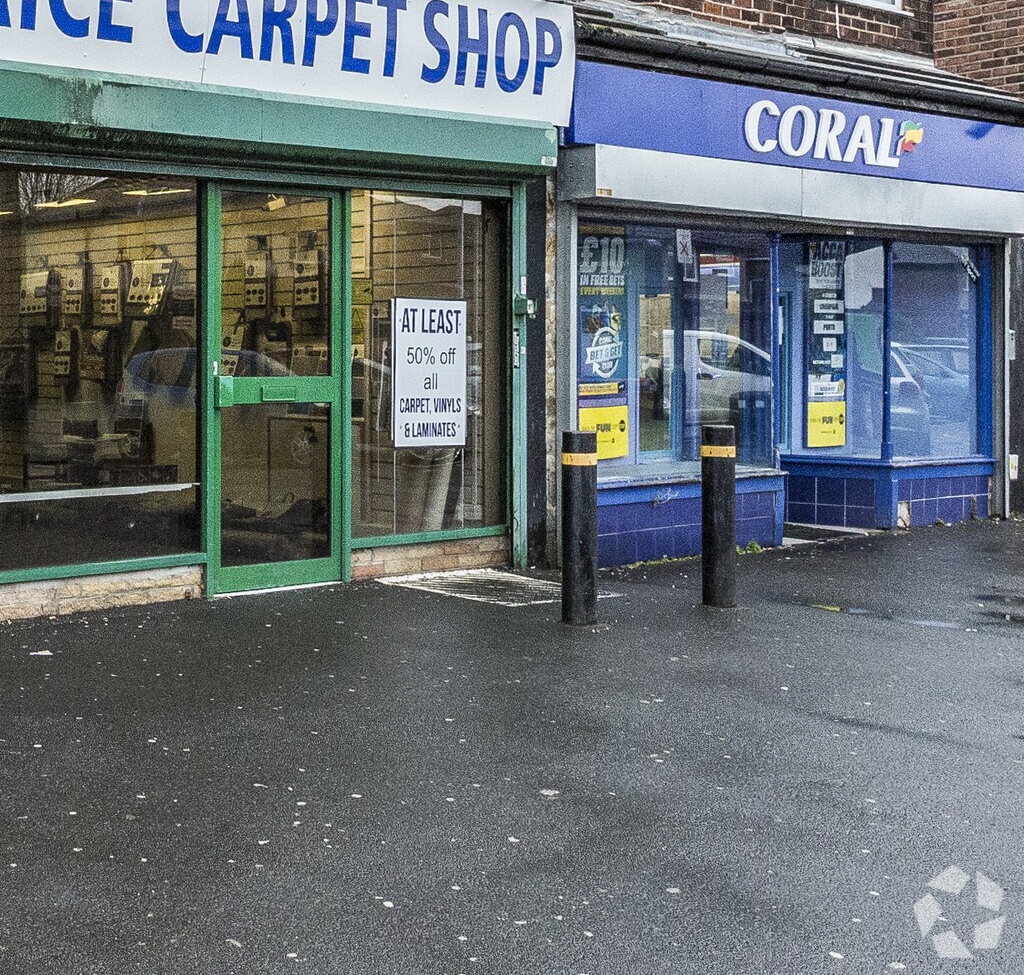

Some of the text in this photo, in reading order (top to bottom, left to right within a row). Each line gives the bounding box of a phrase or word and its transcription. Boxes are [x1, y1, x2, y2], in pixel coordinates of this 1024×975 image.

[420, 0, 563, 96] SHOP
[744, 99, 902, 168] CORAL
[579, 236, 625, 274] £10
[811, 261, 843, 278] BOOST
[579, 275, 625, 286] IN FREE BETS
[401, 307, 461, 334] AT LEAST
[406, 347, 457, 366] 50% off
[589, 349, 603, 361] BET
[423, 372, 438, 390] all
[400, 397, 462, 414] CARPET, VINYLS
[404, 422, 457, 438] & LAMINATES
[596, 423, 611, 432] FUN
